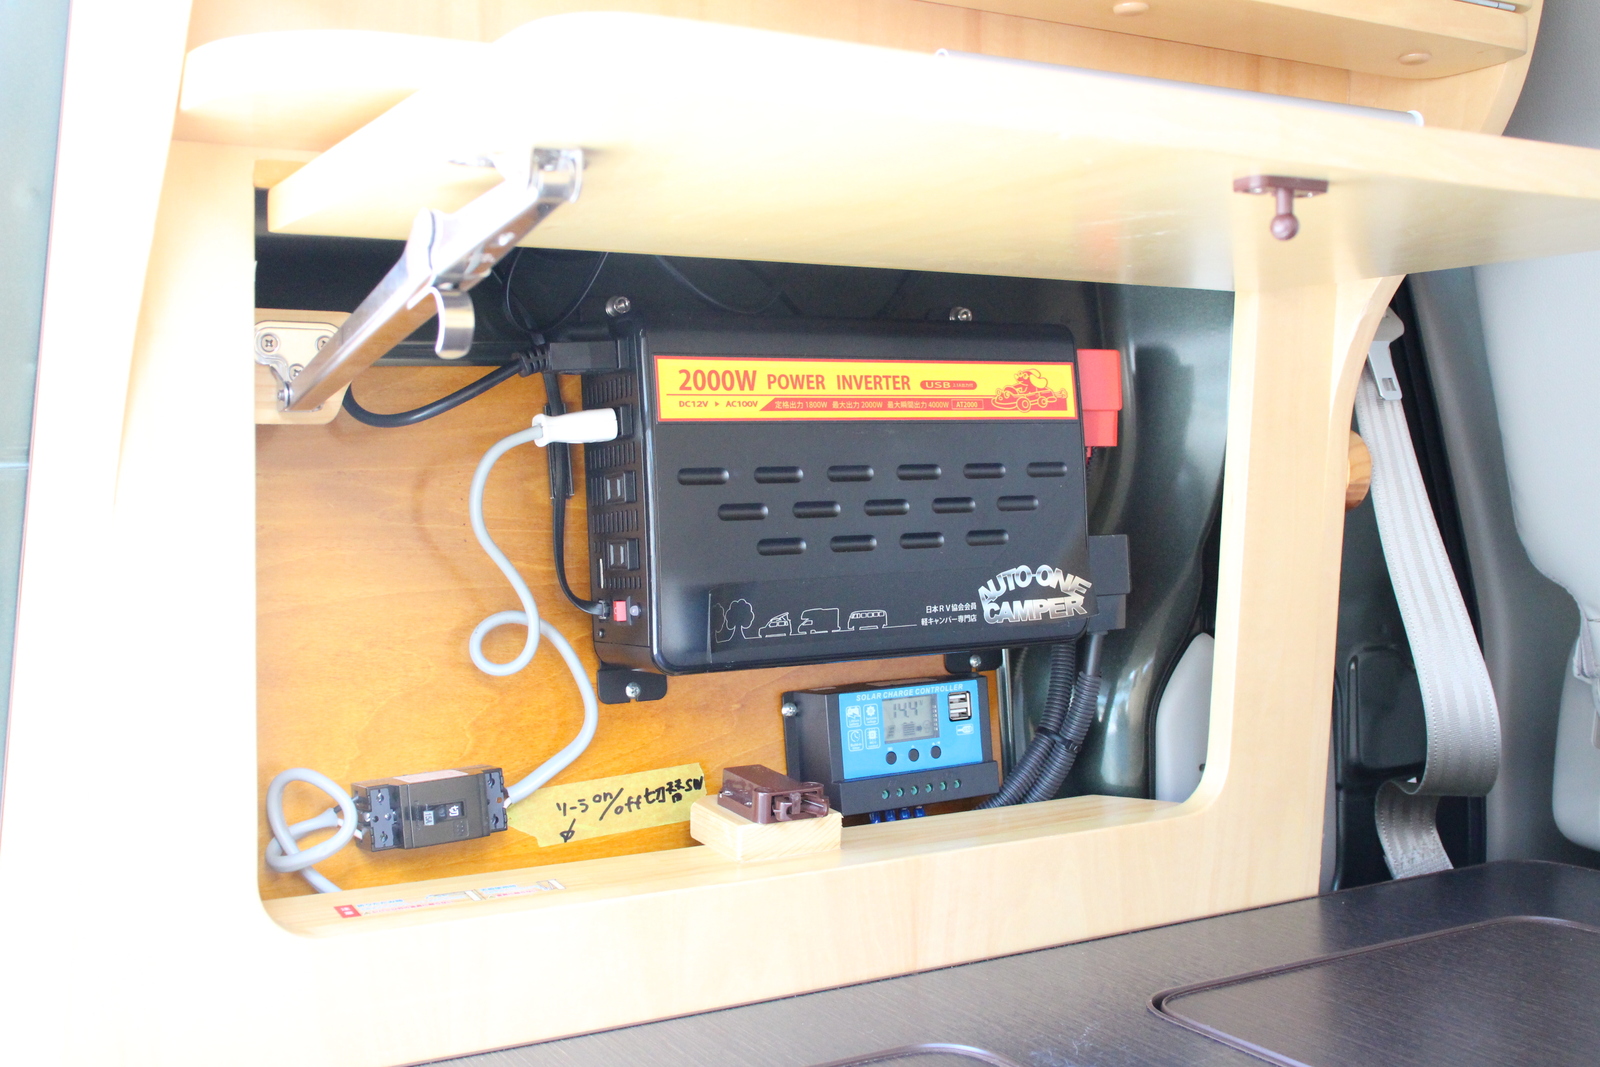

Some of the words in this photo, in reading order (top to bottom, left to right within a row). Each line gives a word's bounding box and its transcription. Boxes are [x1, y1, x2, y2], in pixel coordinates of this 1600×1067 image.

[678, 368, 757, 391] 2000W
[767, 374, 825, 390] POWER
[836, 374, 911, 390] INVERTER
[925, 381, 951, 389] USB
[679, 400, 708, 408] DC12V
[725, 400, 758, 408] AC100V
[956, 401, 978, 409] AT2000
[978, 564, 1093, 603] AUTO-ONE
[983, 596, 1088, 624] CAMPER
[856, 692, 882, 702] SOLAR
[882, 687, 914, 699] CHARGE
[914, 683, 964, 695] CONTROLLER
